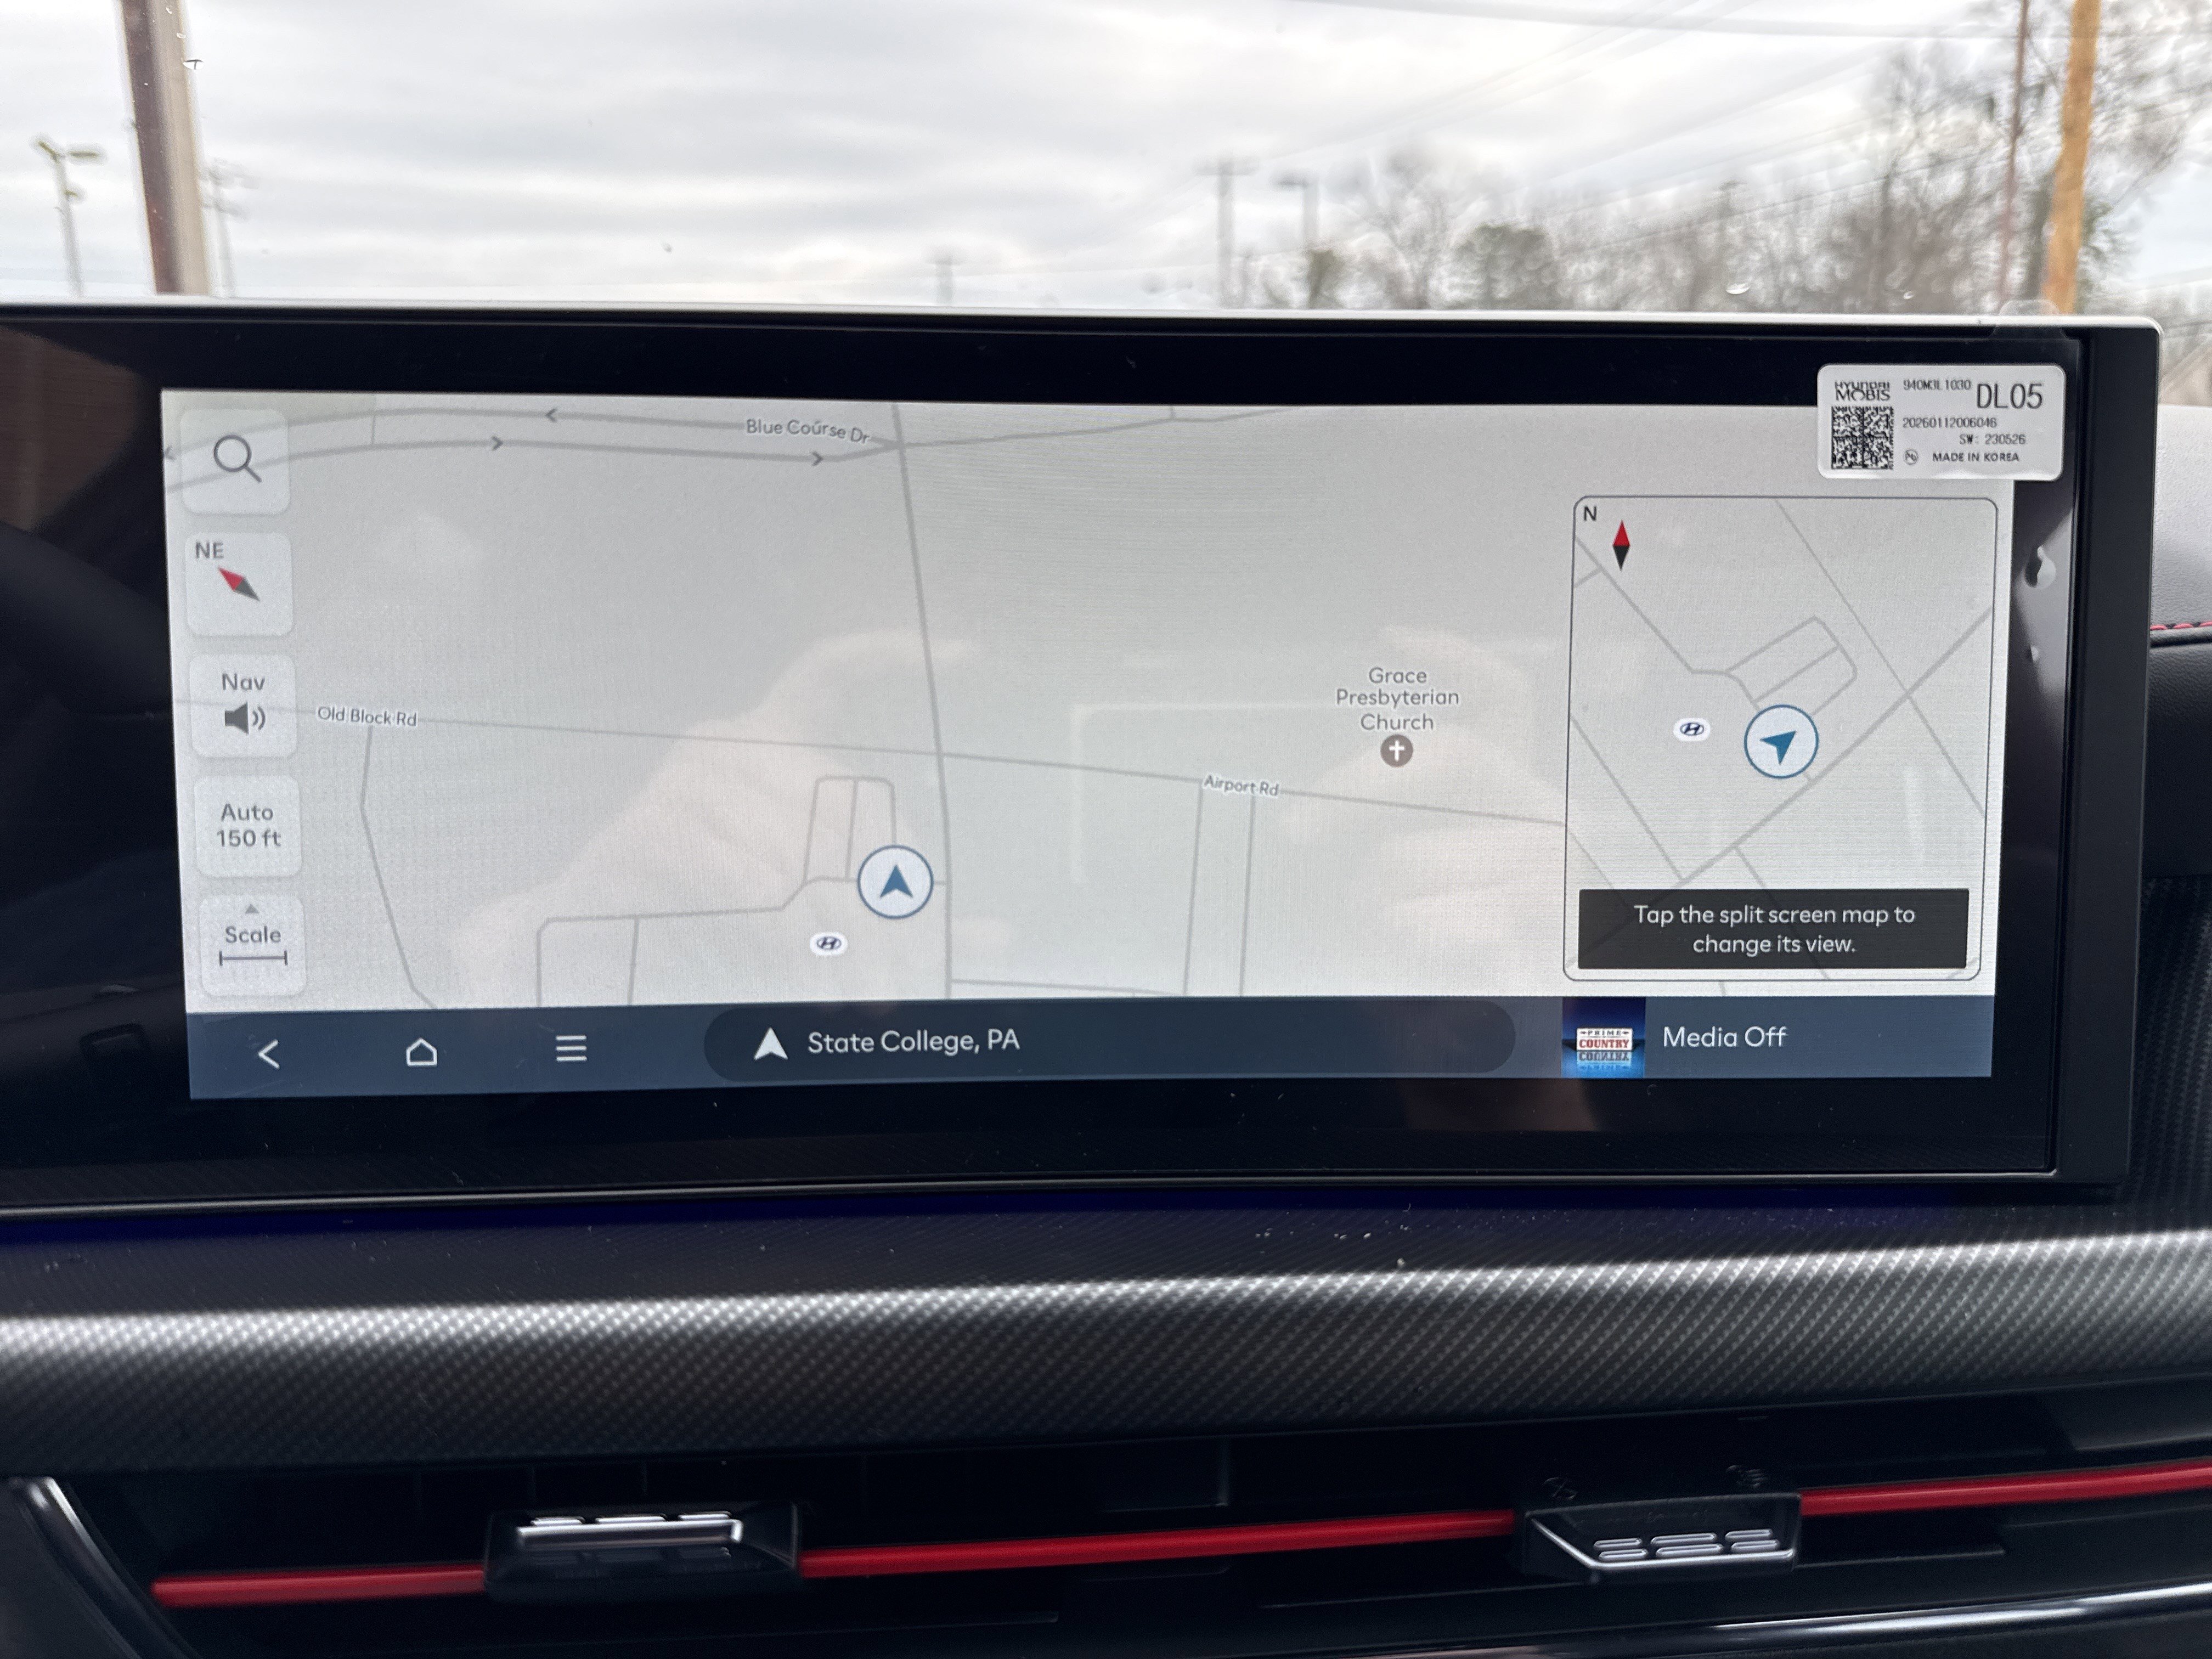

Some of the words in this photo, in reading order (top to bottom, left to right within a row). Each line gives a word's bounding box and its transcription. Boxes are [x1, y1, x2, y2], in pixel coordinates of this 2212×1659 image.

[1835, 389, 1891, 401] MOBIS
[1976, 383, 2043, 409] DL05
[747, 420, 783, 435] Blue
[787, 420, 847, 438] Course
[850, 427, 870, 443] Dr
[1959, 433, 1979, 445] SW:
[1985, 433, 2026, 445] 230526
[1932, 453, 1964, 462] MADE
[1967, 453, 1980, 461] IN
[1984, 453, 2019, 462] KOREA
[1583, 506, 1597, 521] N
[195, 542, 225, 558] NE
[222, 673, 266, 691] Nav
[1368, 667, 1427, 684] Grace
[1336, 689, 1459, 709] Presbyterian
[318, 706, 345, 721] Old
[351, 708, 391, 725] Block
[397, 712, 417, 726] Rd
[1361, 713, 1434, 731] Church
[1205, 775, 1255, 793] Airport
[1260, 782, 1279, 796] Rd
[221, 803, 274, 821] Auto
[217, 830, 256, 848] 150
[262, 830, 281, 848] ft
[1634, 905, 1674, 927] Tap
[1679, 905, 1714, 924] the
[1719, 905, 1764, 927] split
[1768, 909, 1837, 924] screen
[1843, 909, 1889, 927] map
[1895, 907, 1916, 924] to
[225, 926, 281, 944] Scale
[1693, 935, 1771, 957] change
[1778, 935, 1801, 952] its
[1805, 935, 1856, 953] view.
[808, 1031, 875, 1054] State
[881, 1030, 980, 1057] College,
[988, 1028, 1021, 1051] PA
[1579, 1039, 1629, 1048] COUNTRY
[1663, 1026, 1738, 1048] Media
[1745, 1026, 1787, 1047] Off
